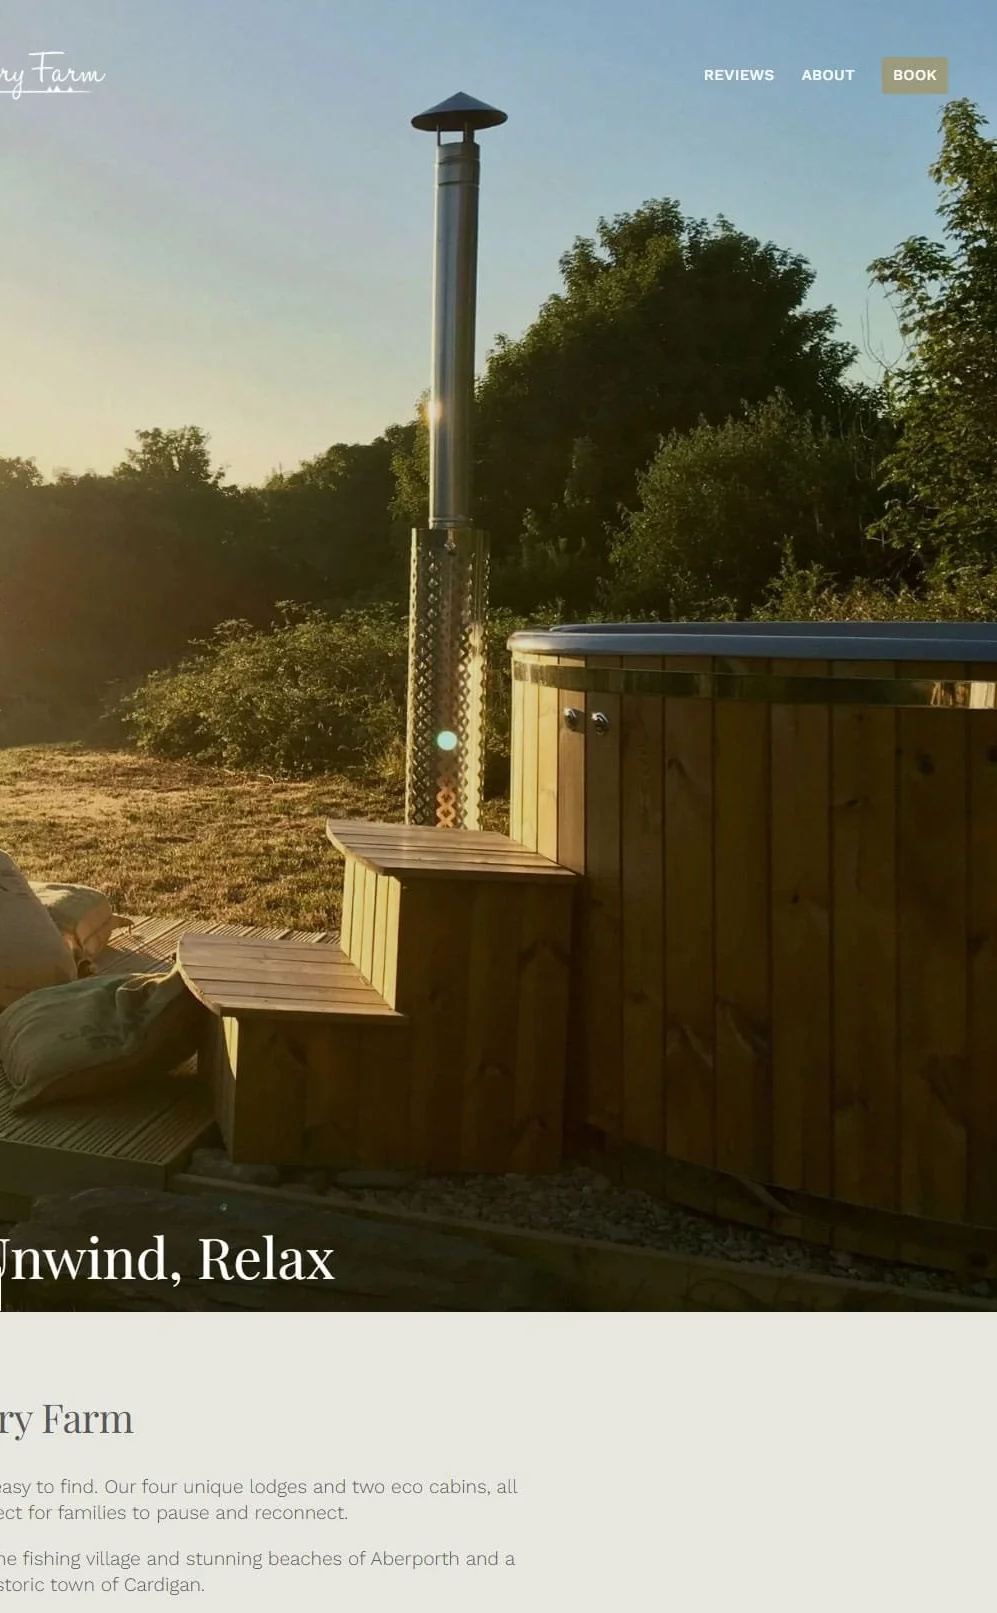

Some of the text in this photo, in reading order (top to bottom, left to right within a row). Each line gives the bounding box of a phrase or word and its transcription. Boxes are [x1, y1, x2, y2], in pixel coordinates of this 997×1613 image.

[41, 1404, 135, 1434] Farm
[35, 1480, 55, 1494] to
[59, 1478, 99, 1494] find.
[104, 1479, 137, 1495] Our
[141, 1478, 178, 1494] four
[183, 1479, 244, 1498] unique
[250, 1478, 307, 1498] lodges
[313, 1478, 346, 1495] and
[351, 1480, 385, 1494] two
[391, 1482, 423, 1494] eco
[429, 1478, 491, 1496] cabins,
[496, 1478, 519, 1494] all
